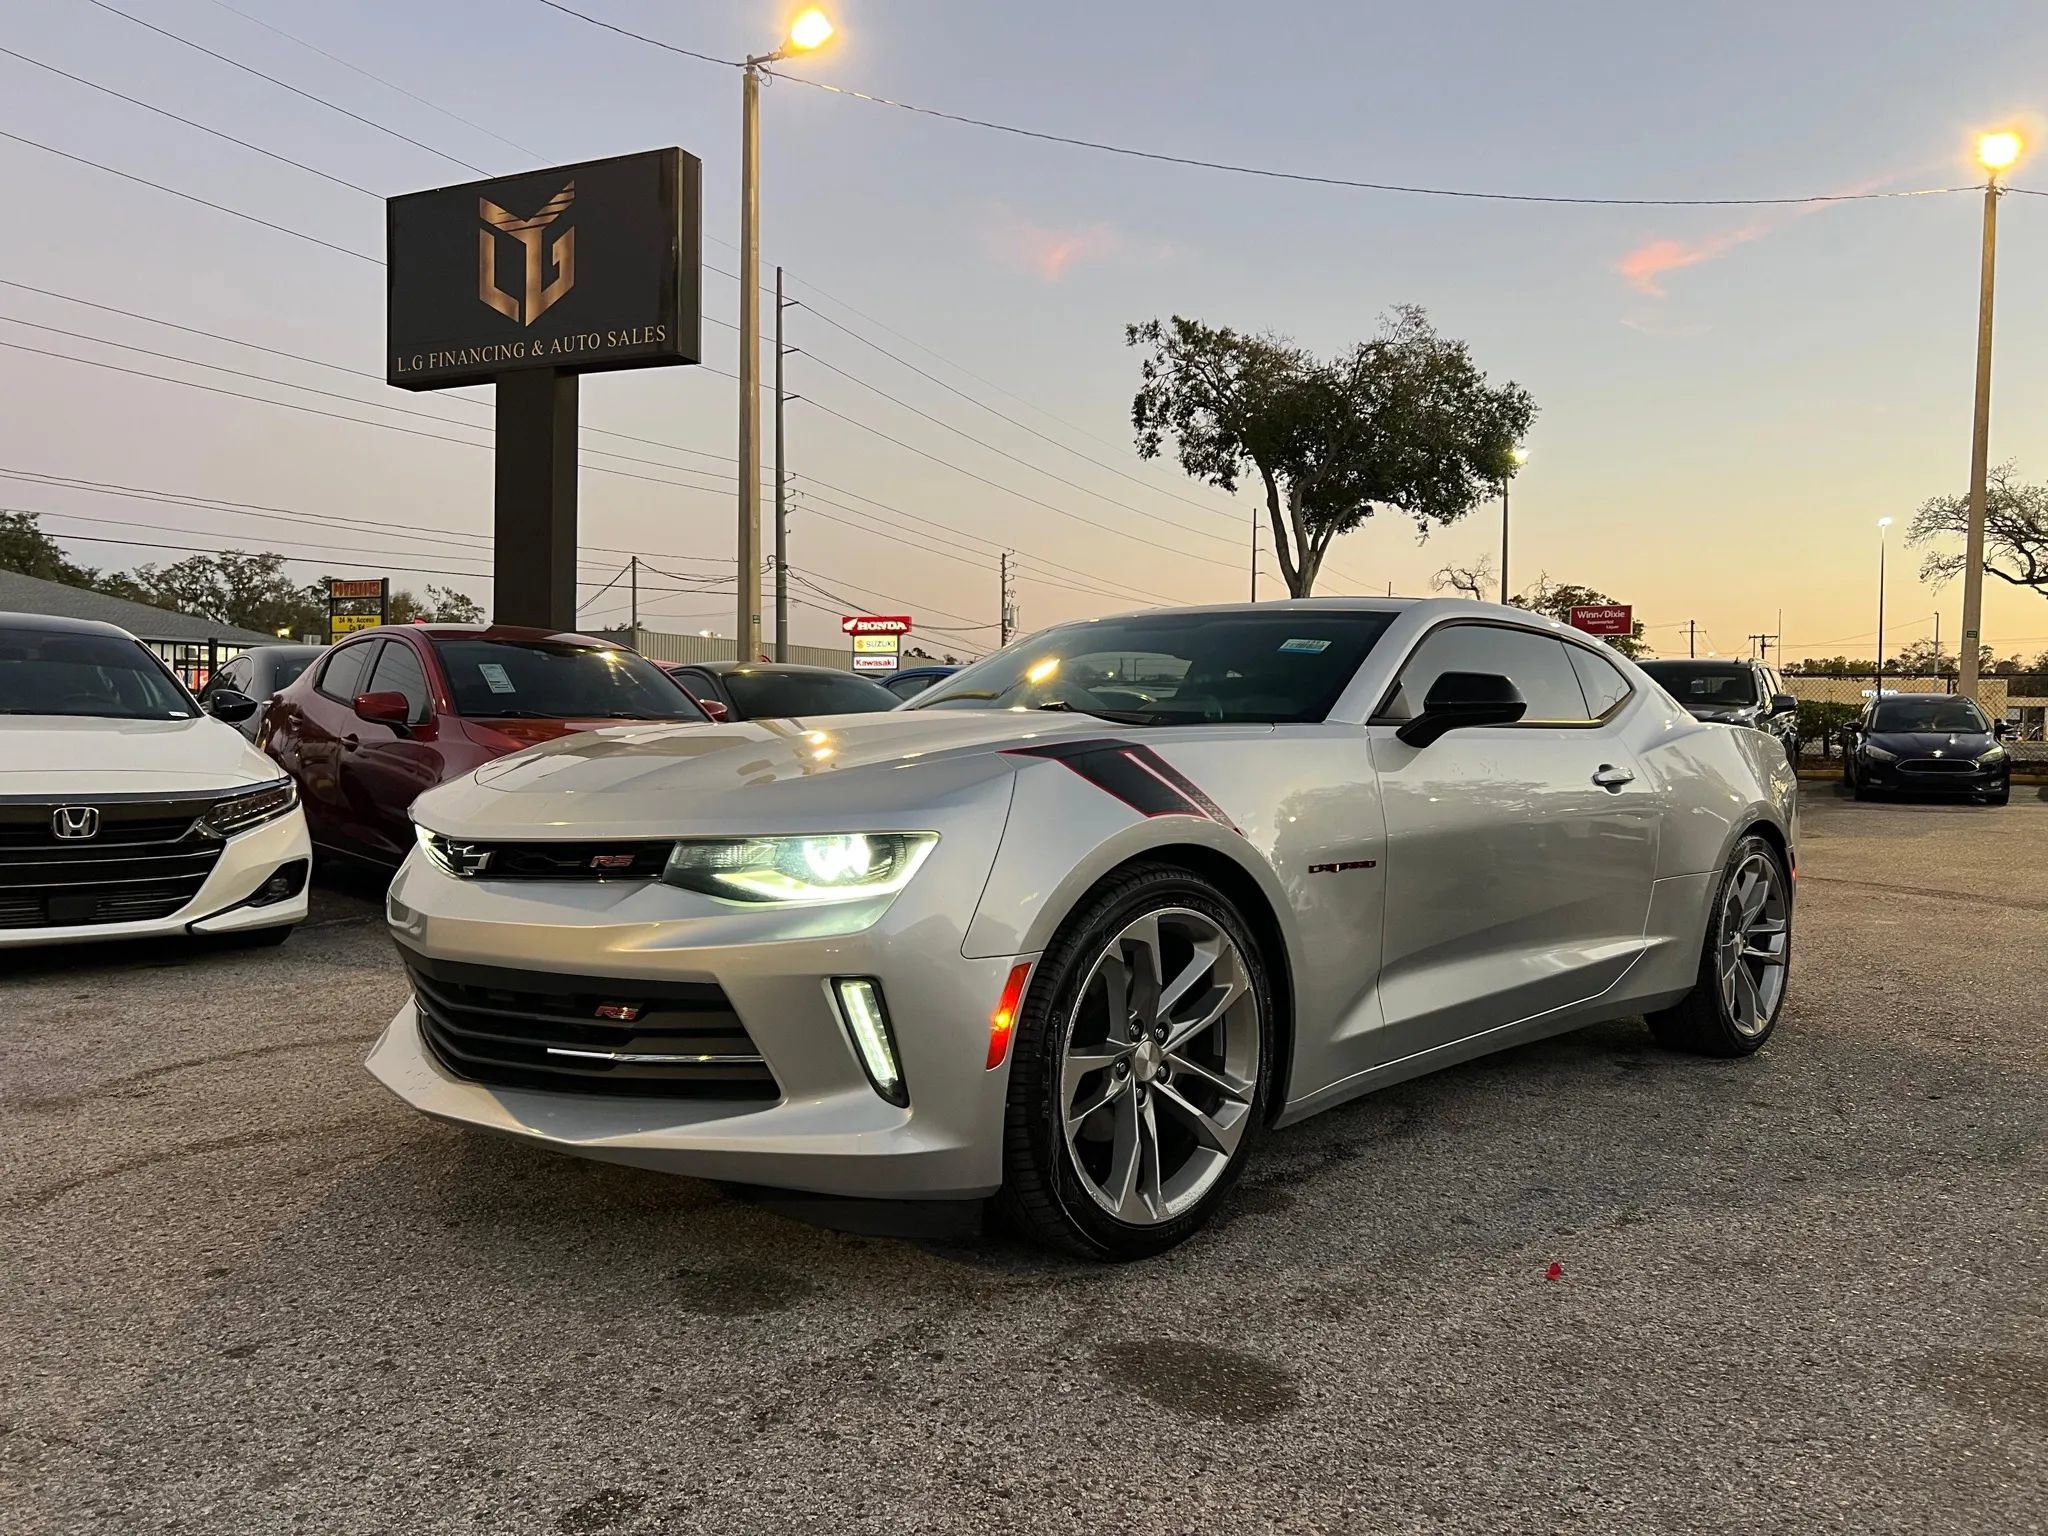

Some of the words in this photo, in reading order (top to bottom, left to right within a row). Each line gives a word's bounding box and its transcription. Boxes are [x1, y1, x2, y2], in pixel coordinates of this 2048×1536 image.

[397, 355, 423, 372] L.G
[429, 342, 525, 369] FINANCING
[531, 339, 544, 356] &
[550, 332, 600, 354] AUTO
[607, 325, 666, 348] SALES
[857, 621, 907, 630] HONDA
[866, 640, 896, 648] SUZUKI
[855, 659, 895, 667] Kawasaki
[589, 854, 636, 868] RS
[594, 1005, 639, 1020] RS
